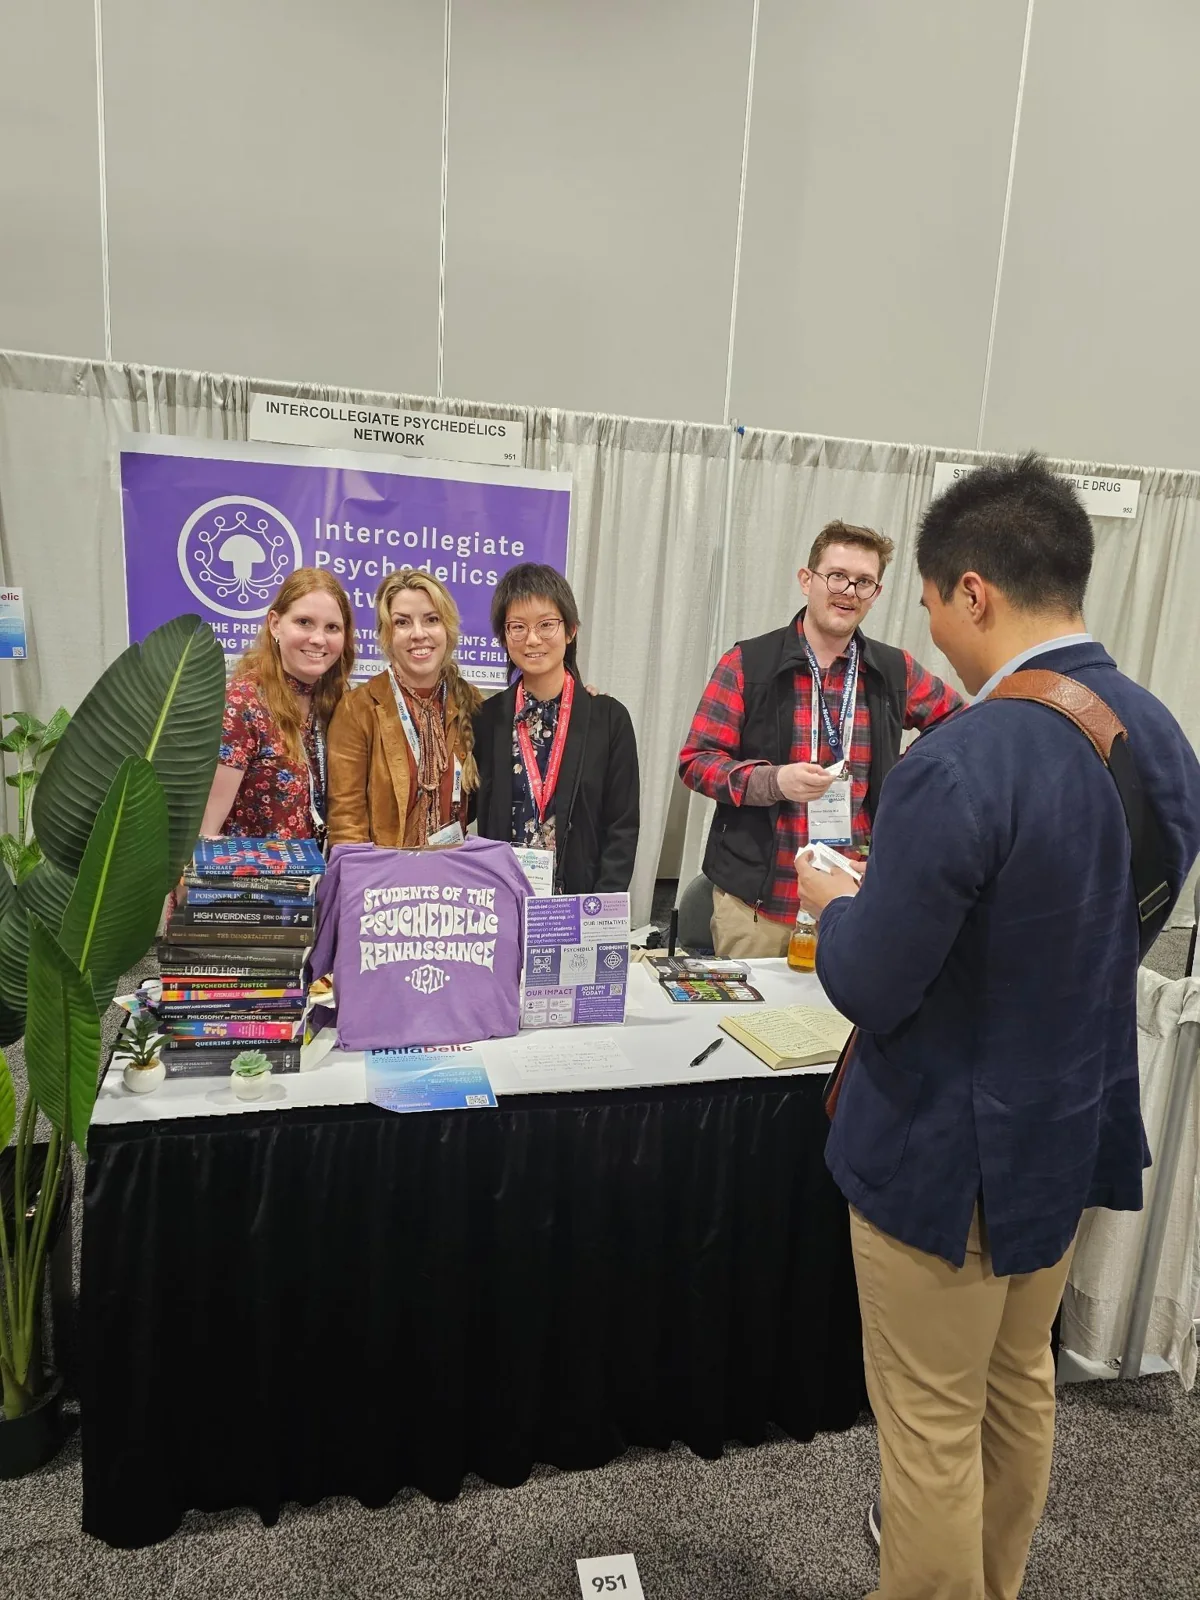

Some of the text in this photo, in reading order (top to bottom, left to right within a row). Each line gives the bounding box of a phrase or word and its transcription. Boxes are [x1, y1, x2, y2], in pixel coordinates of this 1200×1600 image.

[266, 401, 506, 437] INTERCOLLEGIATE PSYCHEDELICS
[354, 428, 425, 446] NETWORK
[1092, 480, 1121, 492] DRUG
[315, 517, 524, 558] Intercollegiate
[490, 637, 500, 648] &
[232, 881, 250, 889] Your
[250, 882, 269, 890] Mind
[363, 885, 496, 912] STUDENTS OF THE
[193, 912, 213, 920] HIGH
[215, 912, 261, 921] WEIRDNESS
[360, 901, 499, 939] PSYCHEDELIC
[359, 939, 497, 975] RENAISSANCE
[184, 966, 219, 975] LIQUID
[221, 966, 251, 975] LIGHT
[526, 989, 542, 997] OUR
[203, 1026, 227, 1037] Trip
[371, 1044, 474, 1056] PhilaDelic
[591, 1574, 628, 1593] 951
